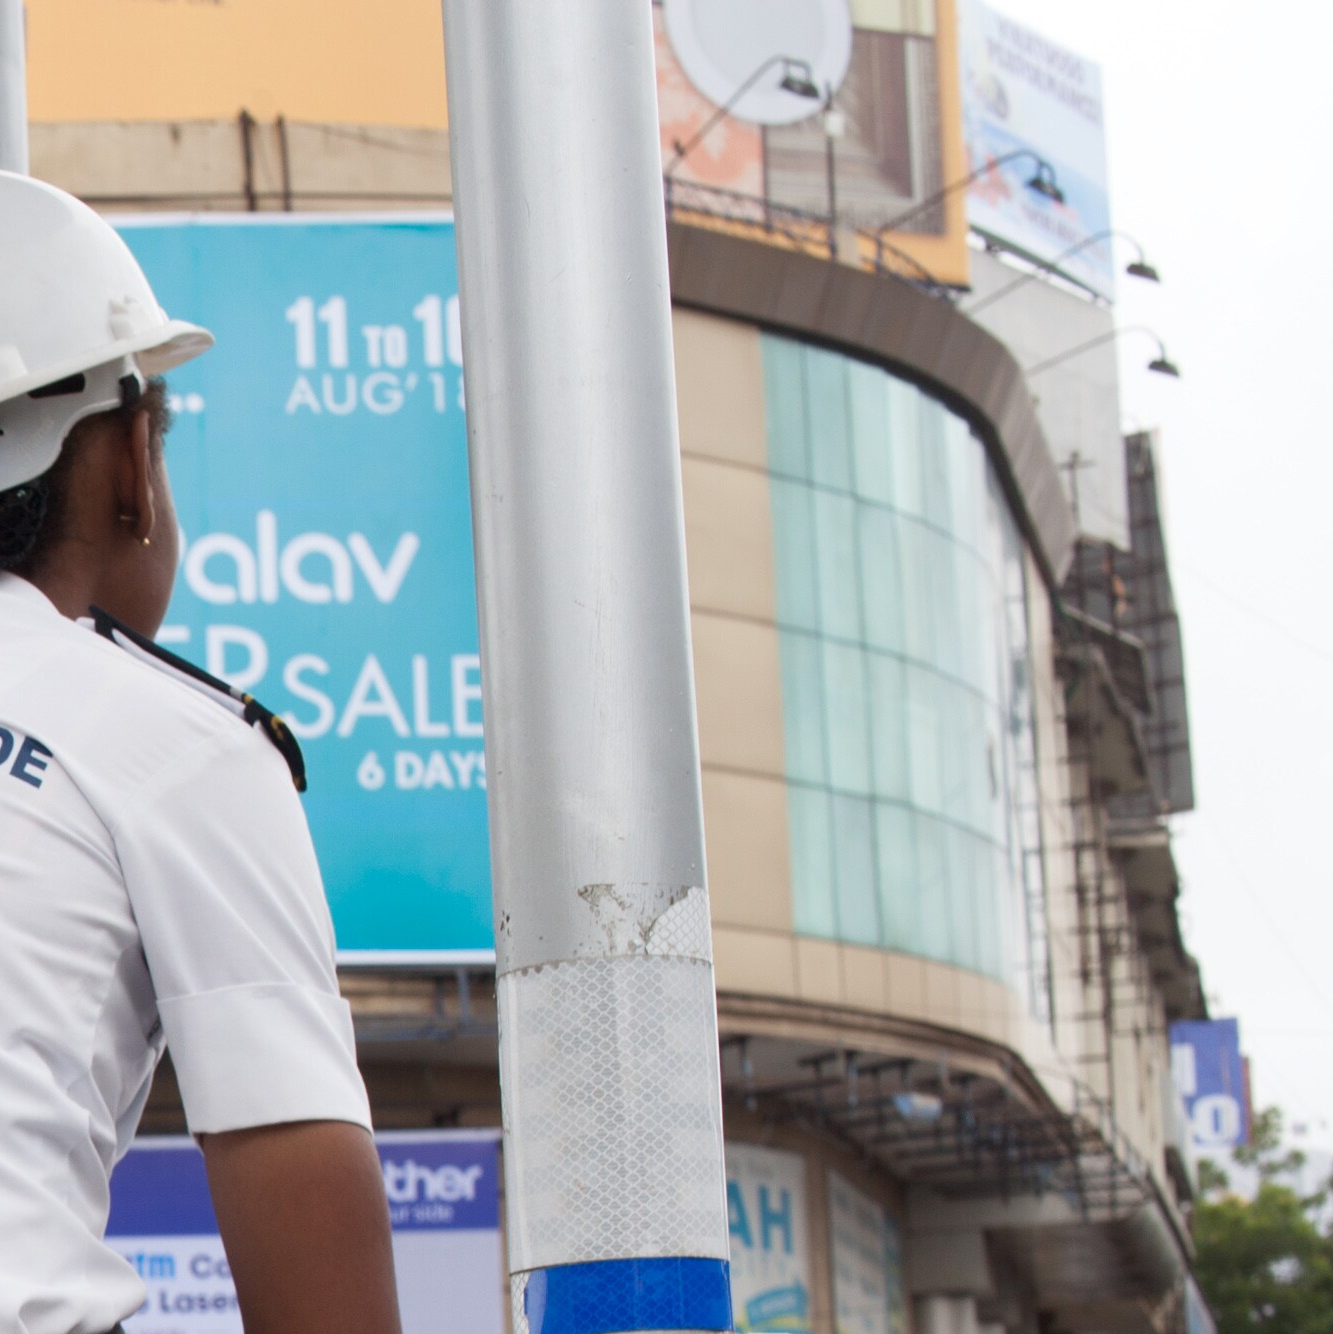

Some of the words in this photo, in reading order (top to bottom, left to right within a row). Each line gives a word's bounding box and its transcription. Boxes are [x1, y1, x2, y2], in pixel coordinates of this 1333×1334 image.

[286, 294, 348, 369] 11
[361, 324, 408, 369] TO
[180, 508, 420, 604] alav
[281, 652, 484, 739] SALE
[356, 751, 386, 791] 6
[383, 1159, 484, 1202] ther
